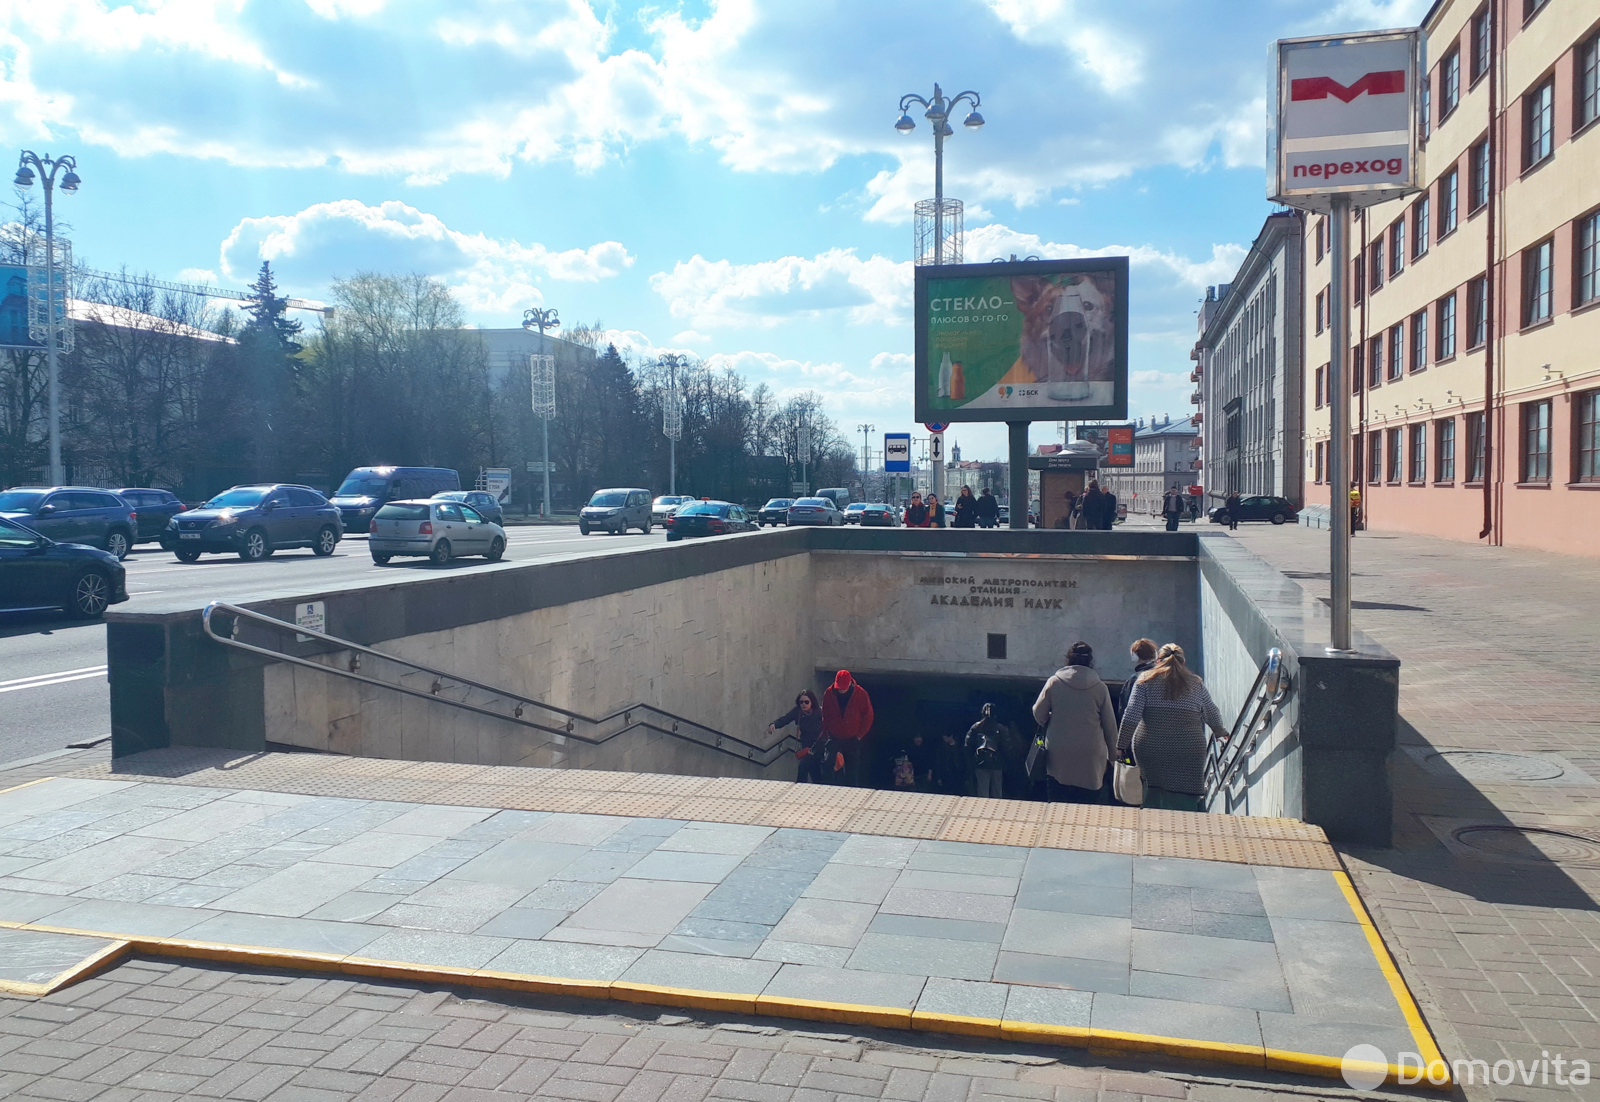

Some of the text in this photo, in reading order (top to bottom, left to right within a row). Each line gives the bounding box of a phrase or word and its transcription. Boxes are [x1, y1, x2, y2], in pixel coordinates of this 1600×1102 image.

[1293, 157, 1403, 180] переход
[930, 315, 970, 324] ПЛЮСОВ
[983, 578, 1077, 588] МЕТРОПОЛИТЕН
[969, 586, 1021, 595] СТАНЦИЯ
[930, 594, 1063, 610] АКАДЕМИЯ НАУК
